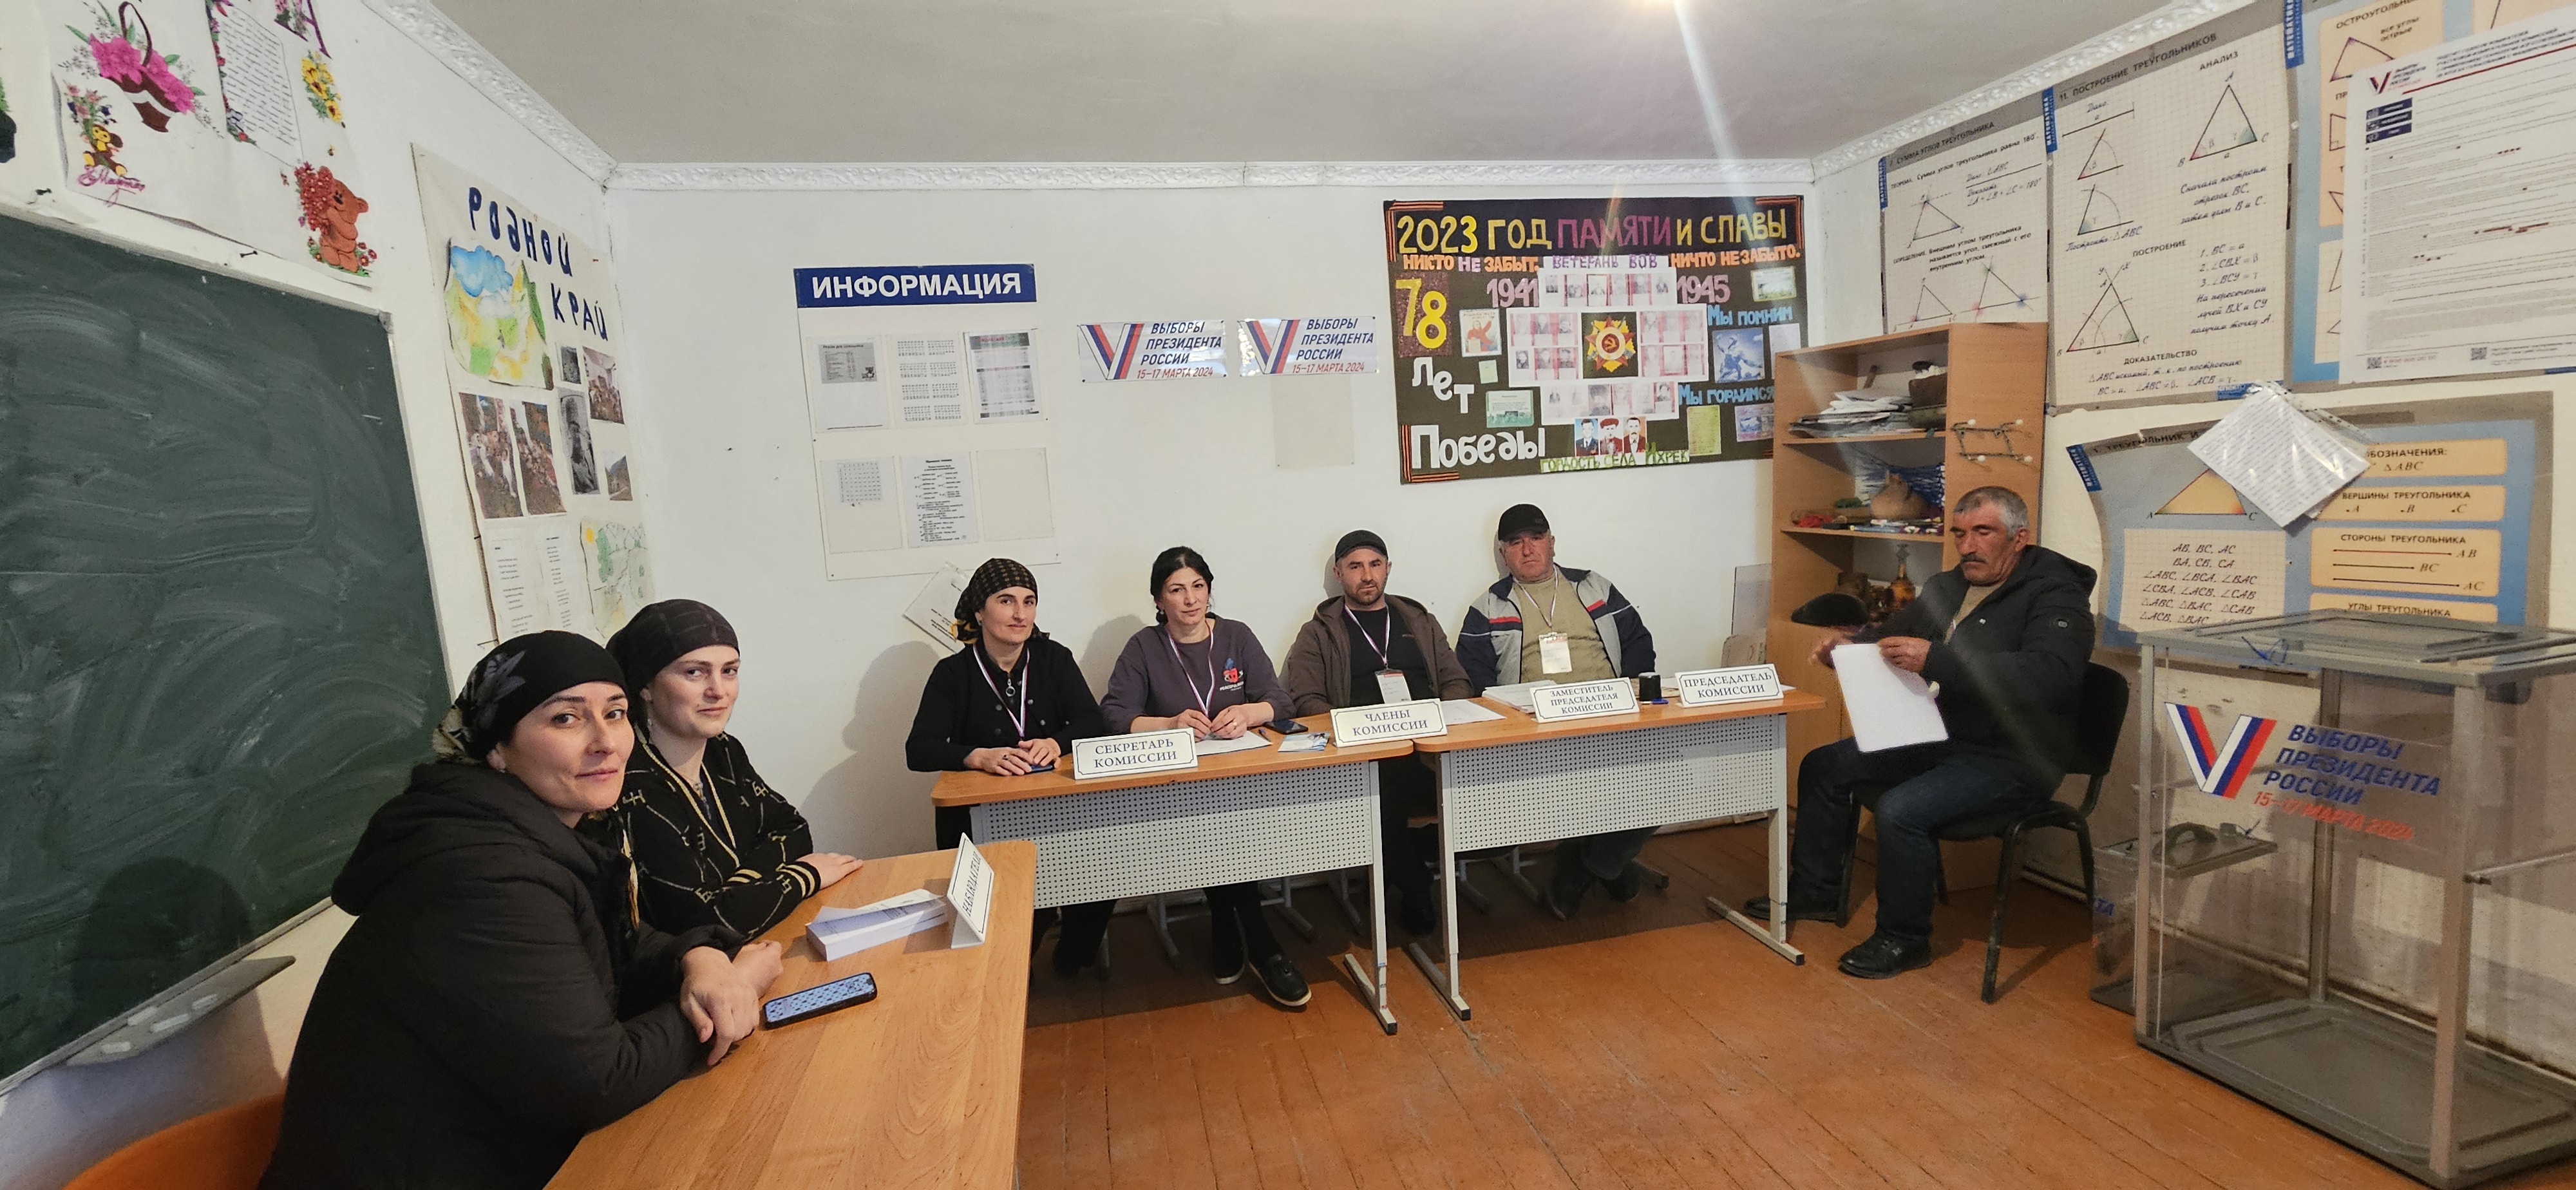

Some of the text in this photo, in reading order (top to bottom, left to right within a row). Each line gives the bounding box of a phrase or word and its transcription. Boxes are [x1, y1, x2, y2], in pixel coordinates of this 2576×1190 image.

[2072, 33, 2217, 96] ПОСТРОЕНИЕ ТРЕУГОЛЬНИКОВ
[2199, 51, 2239, 71] АНАЛИЗ
[1942, 122, 1994, 146] ТРЕУГОЛЬНИКА
[2180, 166, 2266, 194] Сначала построим
[2193, 193, 2228, 205] отрезок
[2181, 213, 2208, 225] затем
[2211, 207, 2231, 218] углы
[1397, 208, 1786, 254] 2023 ГОД ПАМЯТИ И СЛАВЫ
[1979, 225, 2022, 241] треугольника
[2132, 240, 2186, 257] ПОСТРОЕНИЕ
[1403, 254, 1539, 272] НИКТО НЕ ЗАБЫТ.
[1629, 253, 1658, 269] ВОВ
[1671, 252, 1716, 268] НИЧТО
[812, 273, 1021, 299] ИНФОРМАЦИЯ
[1486, 278, 1539, 308] 1941
[1677, 274, 1730, 304] 1945
[2197, 287, 2267, 303] На пересечении
[551, 282, 608, 341] КРАЙ
[1396, 278, 1447, 348] 78
[1707, 304, 1733, 326] Мы
[2197, 306, 2222, 319] лучей
[1151, 322, 1205, 334] ВЫБОРЫ
[1306, 318, 1358, 330] ВЫБОРЫ
[2191, 324, 2227, 334] получим
[2230, 319, 2259, 330] точку
[1146, 337, 1222, 350] ПРЕЗИДЕНТА
[1301, 333, 1374, 346] ПРЕЗИДЕНТА
[1141, 353, 1190, 366] РОССИИ
[1296, 348, 1343, 361] РОССИИ
[2124, 350, 2197, 365] ДОКАЗАТЕЛЬСТВО
[1162, 368, 1191, 378] МАРТА
[1193, 367, 1213, 377] 2024
[1316, 363, 1344, 373] МАРТА
[1345, 362, 1365, 372] 2024
[2189, 359, 2242, 371] построению
[1678, 384, 1702, 405] Мы
[1410, 424, 1545, 469] Победы
[1540, 442, 1689, 473] ГОРДОСТЬ СЕЛА ИХРЕК
[2392, 534, 2466, 544] ТРЕУГОЛЬНИКА
[2377, 605, 2451, 617] ТРЕУГОЛЬНИКА
[1683, 672, 1772, 687] ПРЕДСЕДАТЕЛЬ
[1550, 685, 1613, 697] ЗАМЕСТИТЕЛЬ
[1698, 685, 1765, 698] КОМИССИИ
[1551, 693, 1618, 706] ПРЕДСЕДАТЕЛЯ
[1365, 710, 1410, 722] ЧЛЕНЫ
[1561, 703, 1613, 714] КОМИССИИ
[1352, 720, 1428, 736] КОМИССИИ
[1095, 739, 1173, 754] СЕКРЕТАРЬ
[2288, 724, 2405, 760] ВЫБОРЫ
[1095, 751, 1177, 768] КОМИССИИ
[2276, 747, 2441, 796] ПРЕЗИДЕНТА
[2264, 770, 2364, 804] РОССИИ
[2301, 803, 2365, 831] МАРТА
[962, 851, 981, 918] НАБЛЮДАТЕЛИ
